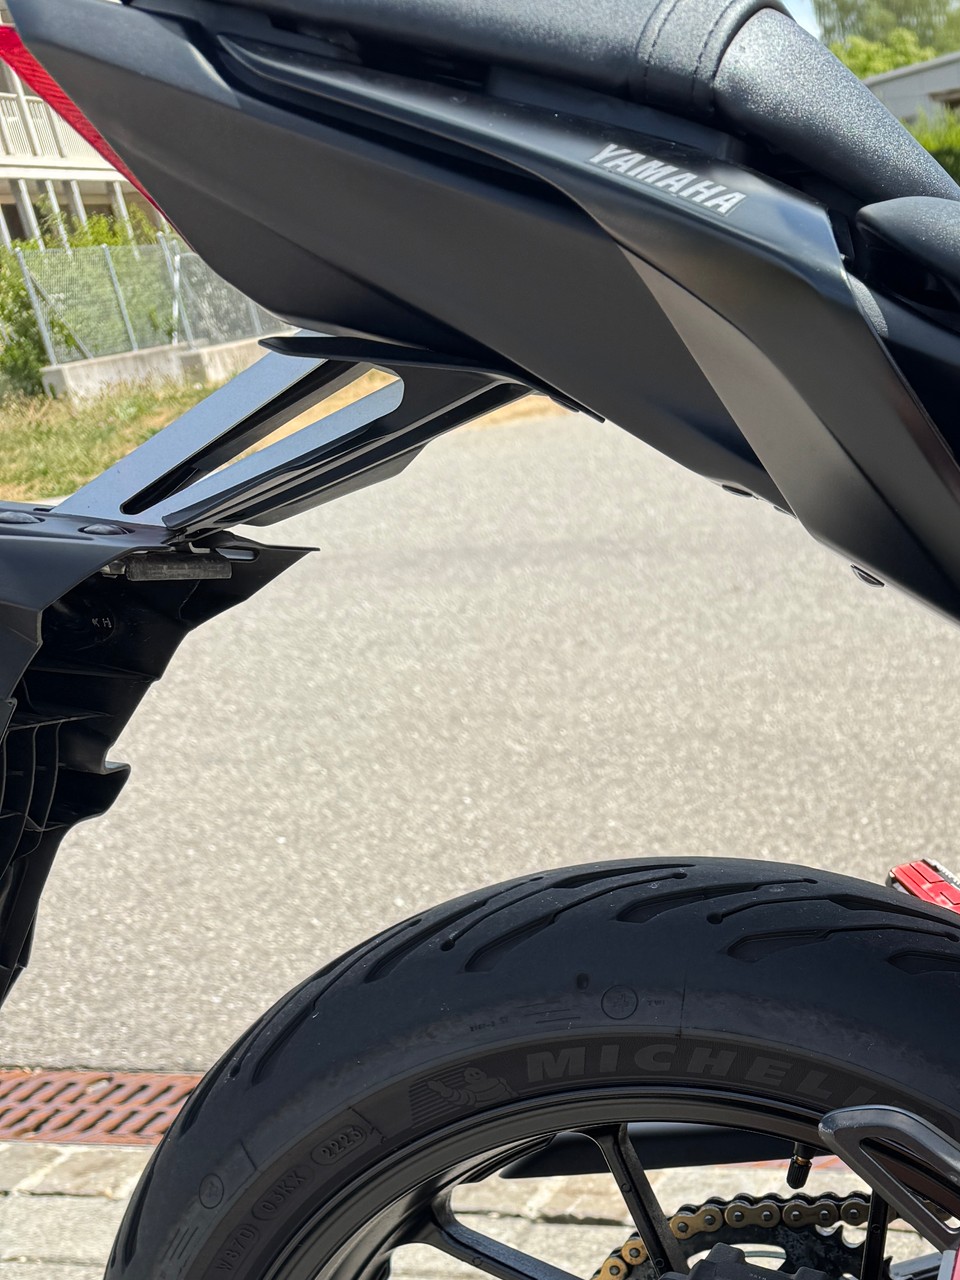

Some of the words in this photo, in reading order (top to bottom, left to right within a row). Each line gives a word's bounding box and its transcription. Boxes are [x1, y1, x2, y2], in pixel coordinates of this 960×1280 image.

[589, 143, 747, 214] YAMAHA
[527, 1043, 938, 1123] MICHELI
[322, 1126, 363, 1158] 2223
[262, 1170, 306, 1211] 03KX
